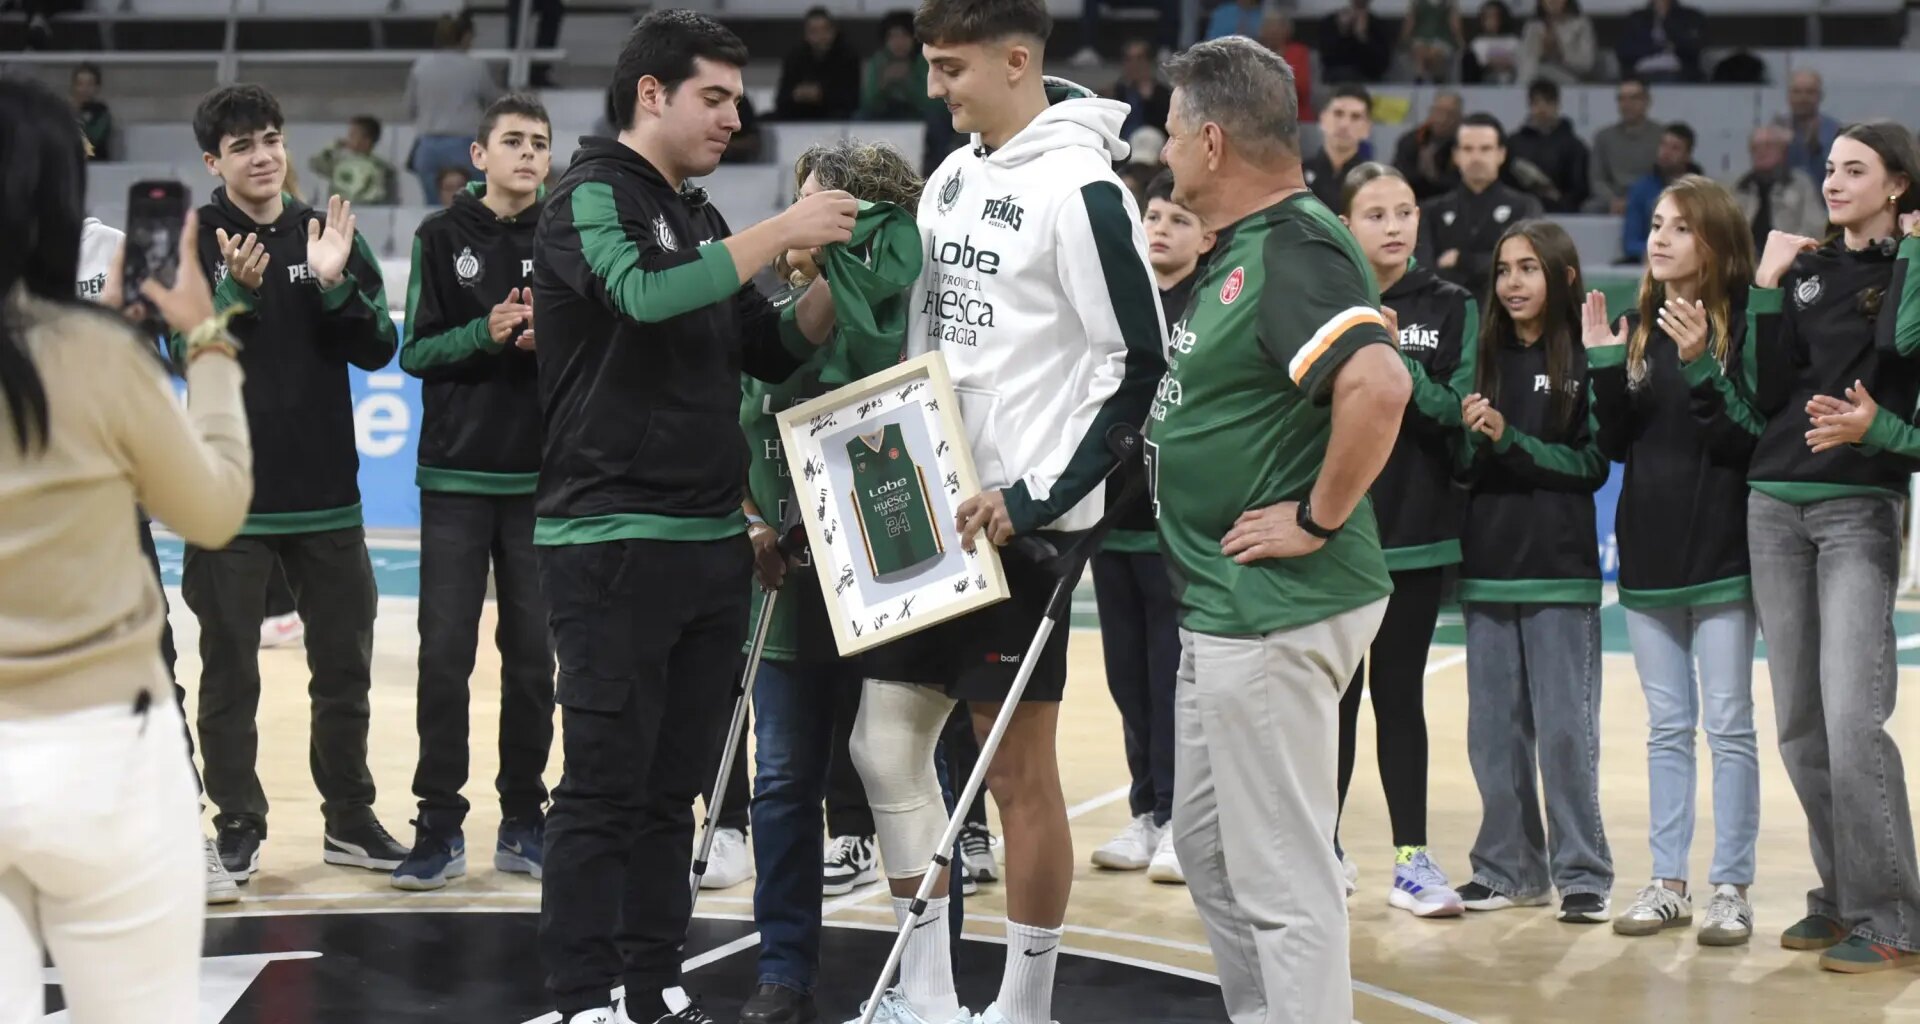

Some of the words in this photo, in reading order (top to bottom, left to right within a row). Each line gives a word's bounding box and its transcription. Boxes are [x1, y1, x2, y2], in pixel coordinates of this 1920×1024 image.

[931, 234, 1000, 275] Lobe
[1398, 323, 1440, 349] EÑAS
[869, 477, 907, 497] Lobe
[885, 511, 911, 538] 24
